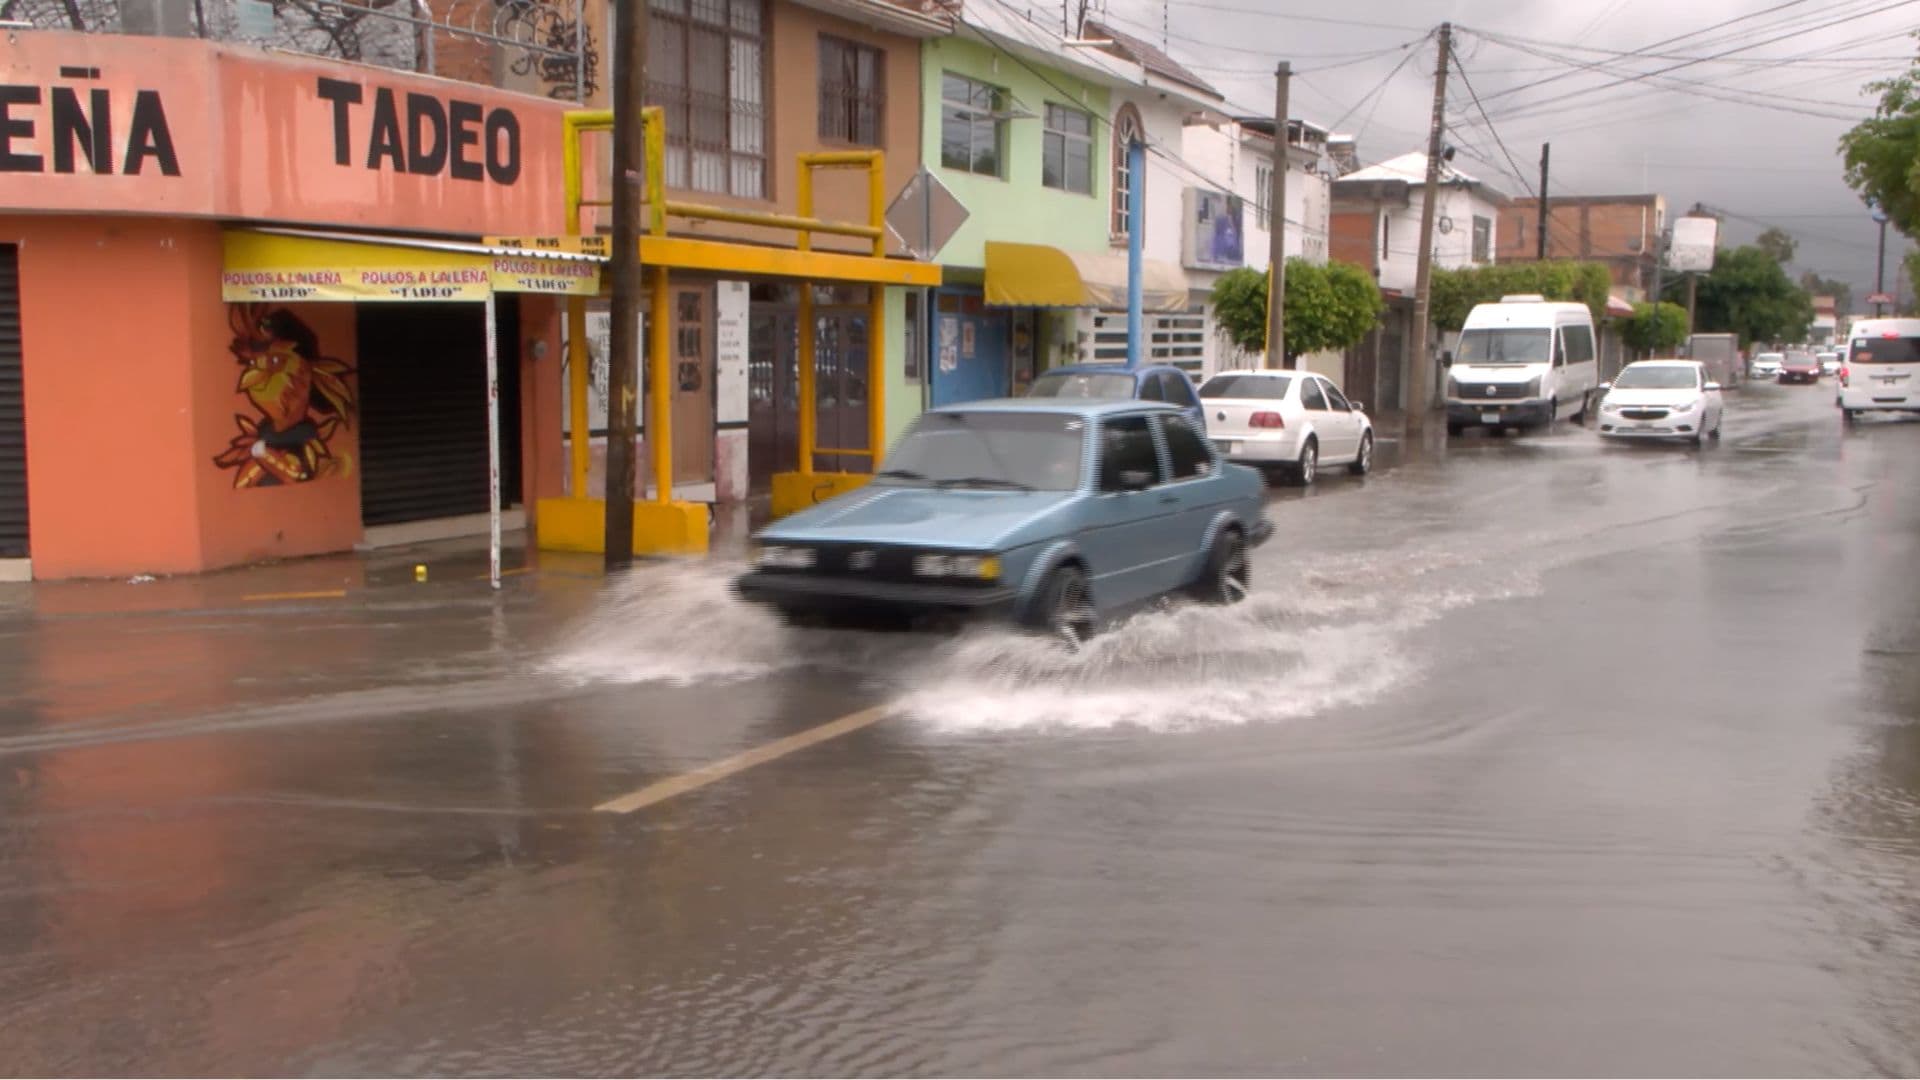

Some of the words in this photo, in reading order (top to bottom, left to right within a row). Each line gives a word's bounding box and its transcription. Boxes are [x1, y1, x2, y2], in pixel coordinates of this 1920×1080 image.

[317, 77, 521, 186] TADEO
[494, 259, 537, 274] POLLOS
[539, 263, 546, 275] A
[223, 271, 273, 285] POLLOS
[275, 272, 286, 285] A
[307, 269, 342, 285] LEÑA
[361, 271, 413, 285] POLLOS
[418, 271, 427, 284] A
[431, 271, 448, 284] LA
[452, 267, 488, 284] LEÑA
